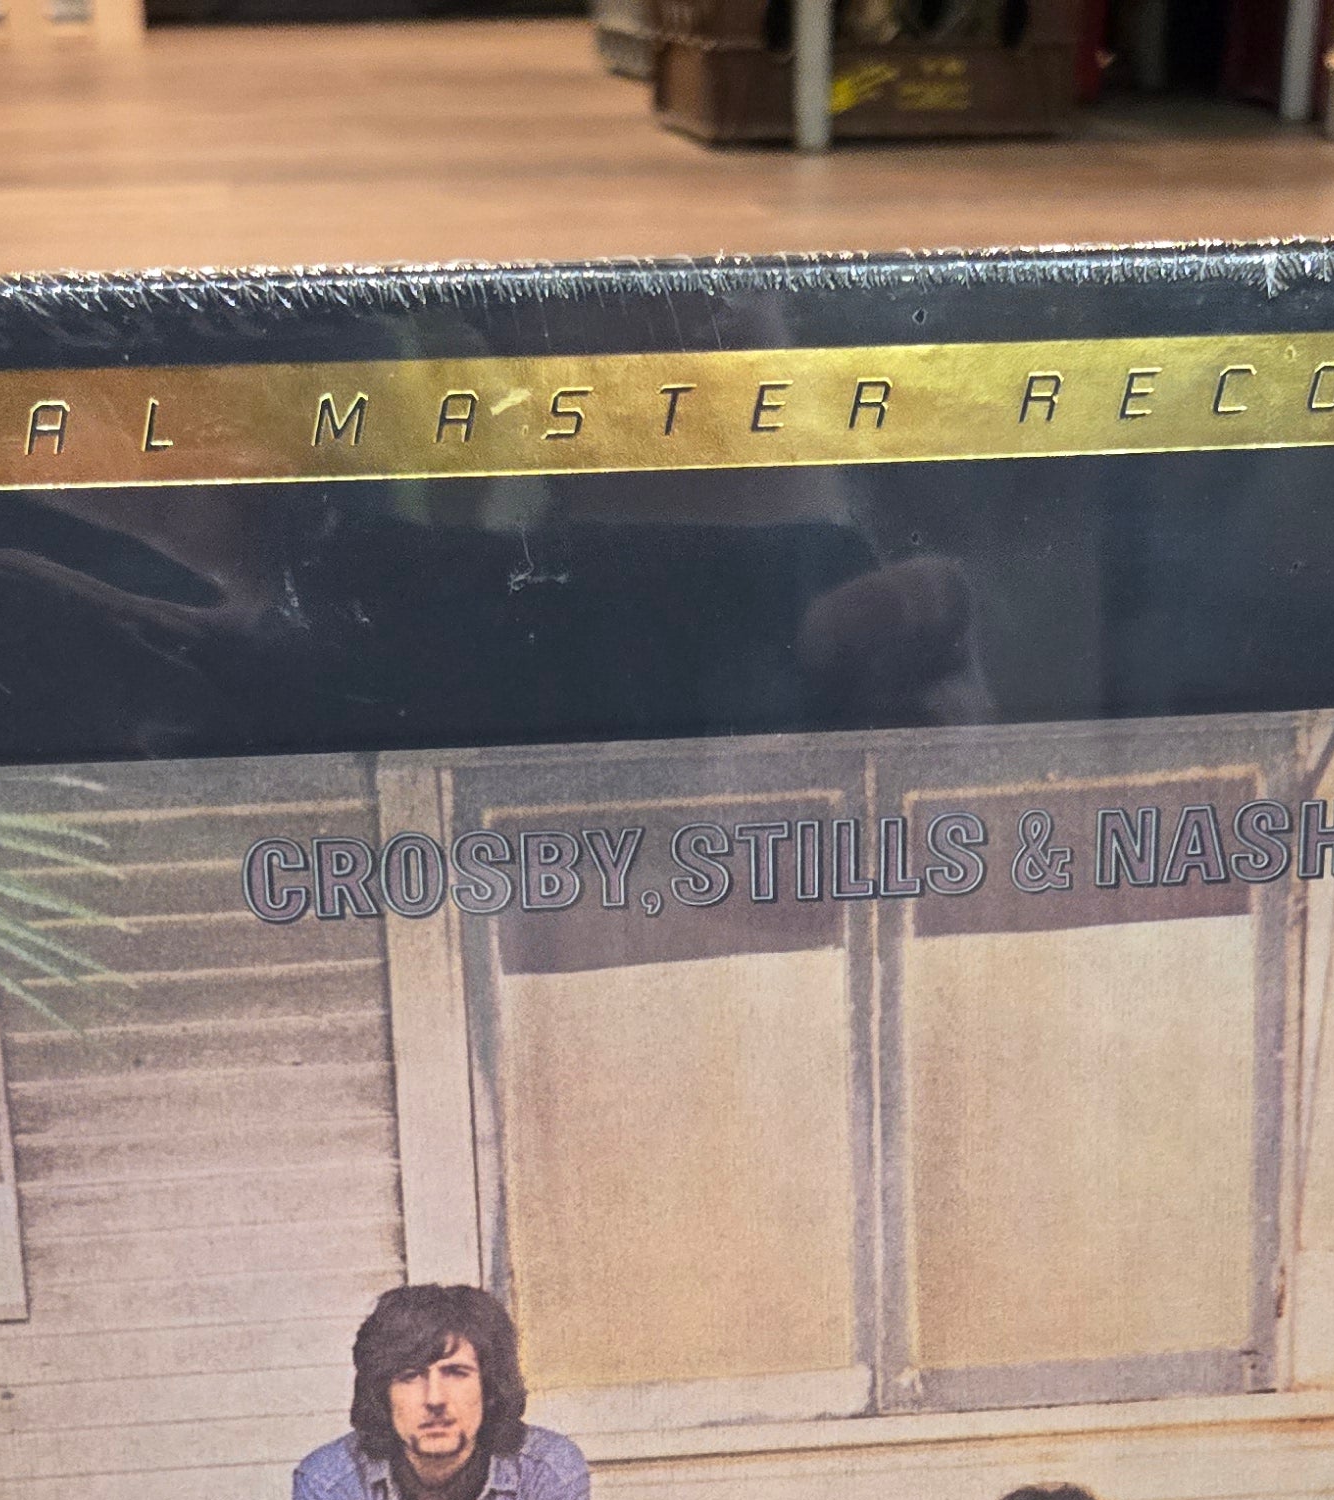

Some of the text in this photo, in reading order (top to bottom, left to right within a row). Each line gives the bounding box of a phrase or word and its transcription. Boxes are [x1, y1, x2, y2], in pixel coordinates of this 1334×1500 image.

[311, 376, 893, 447] MASTER
[241, 827, 662, 925] CROSBY,
[669, 811, 987, 909] STILLS
[1011, 809, 1073, 894] &
